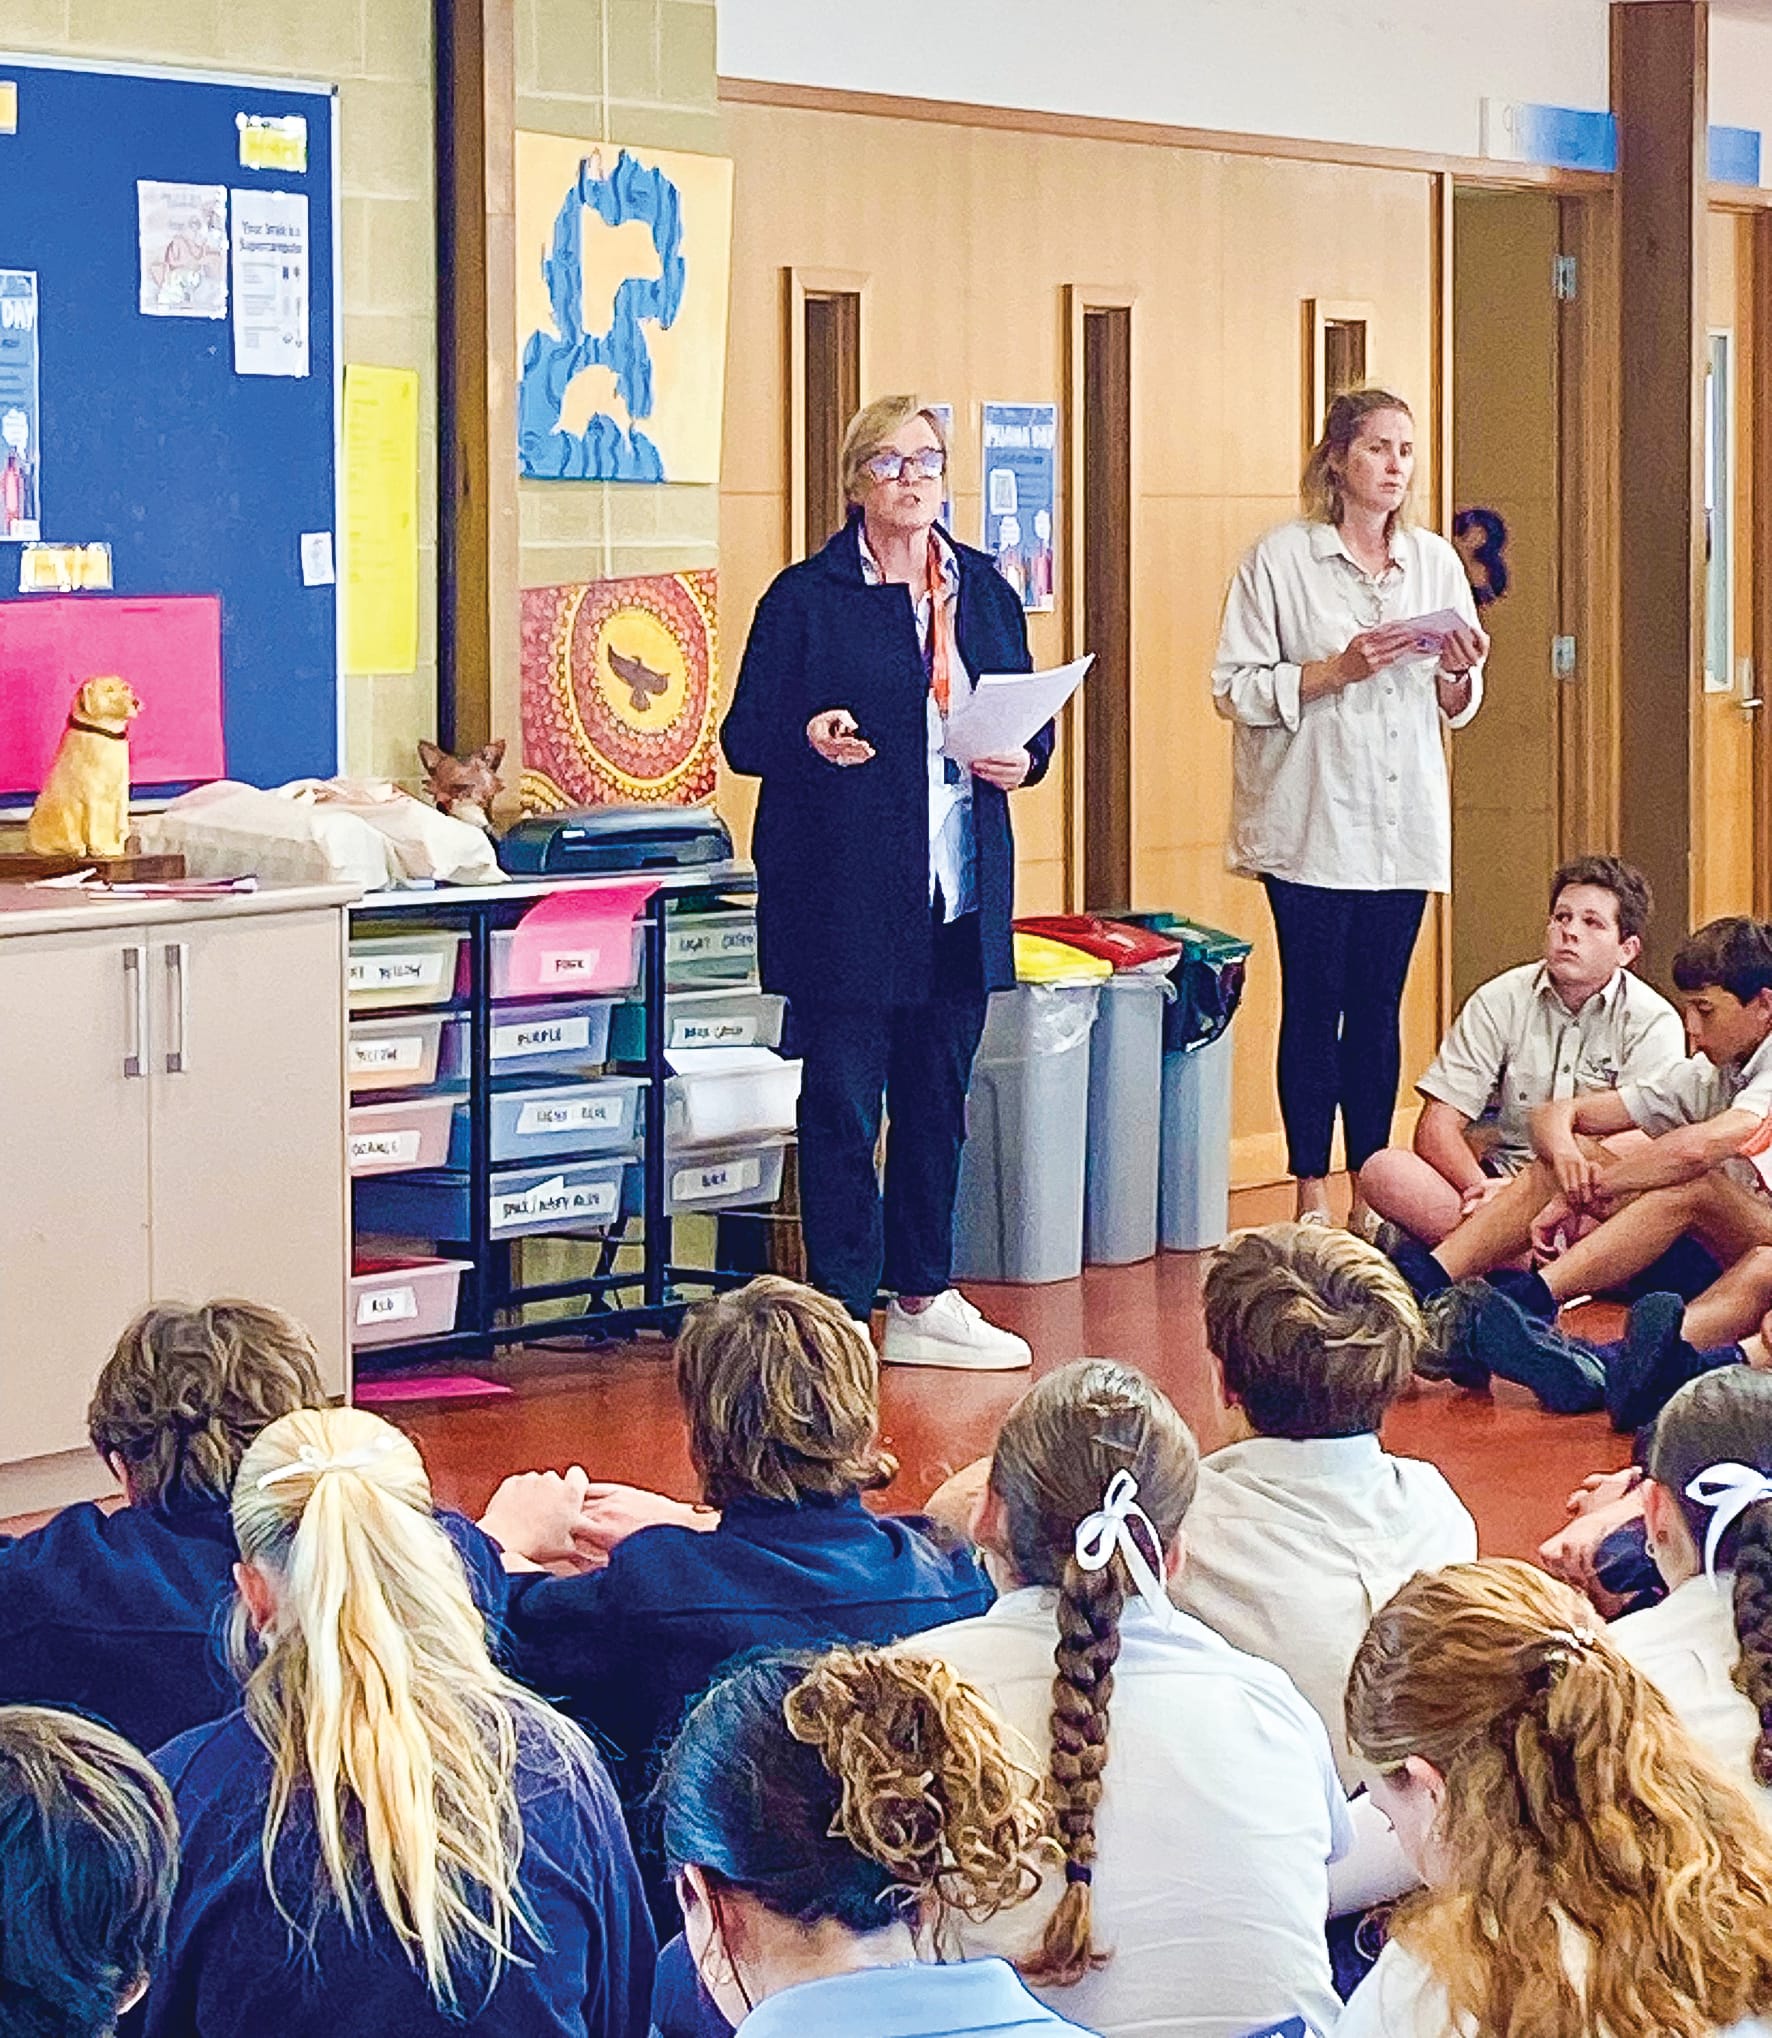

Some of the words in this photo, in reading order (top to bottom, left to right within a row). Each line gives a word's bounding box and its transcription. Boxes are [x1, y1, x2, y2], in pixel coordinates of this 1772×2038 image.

[1453, 508, 1507, 604] 3
[517, 1027, 562, 1046] PURPLE
[372, 1297, 394, 1313] RED
